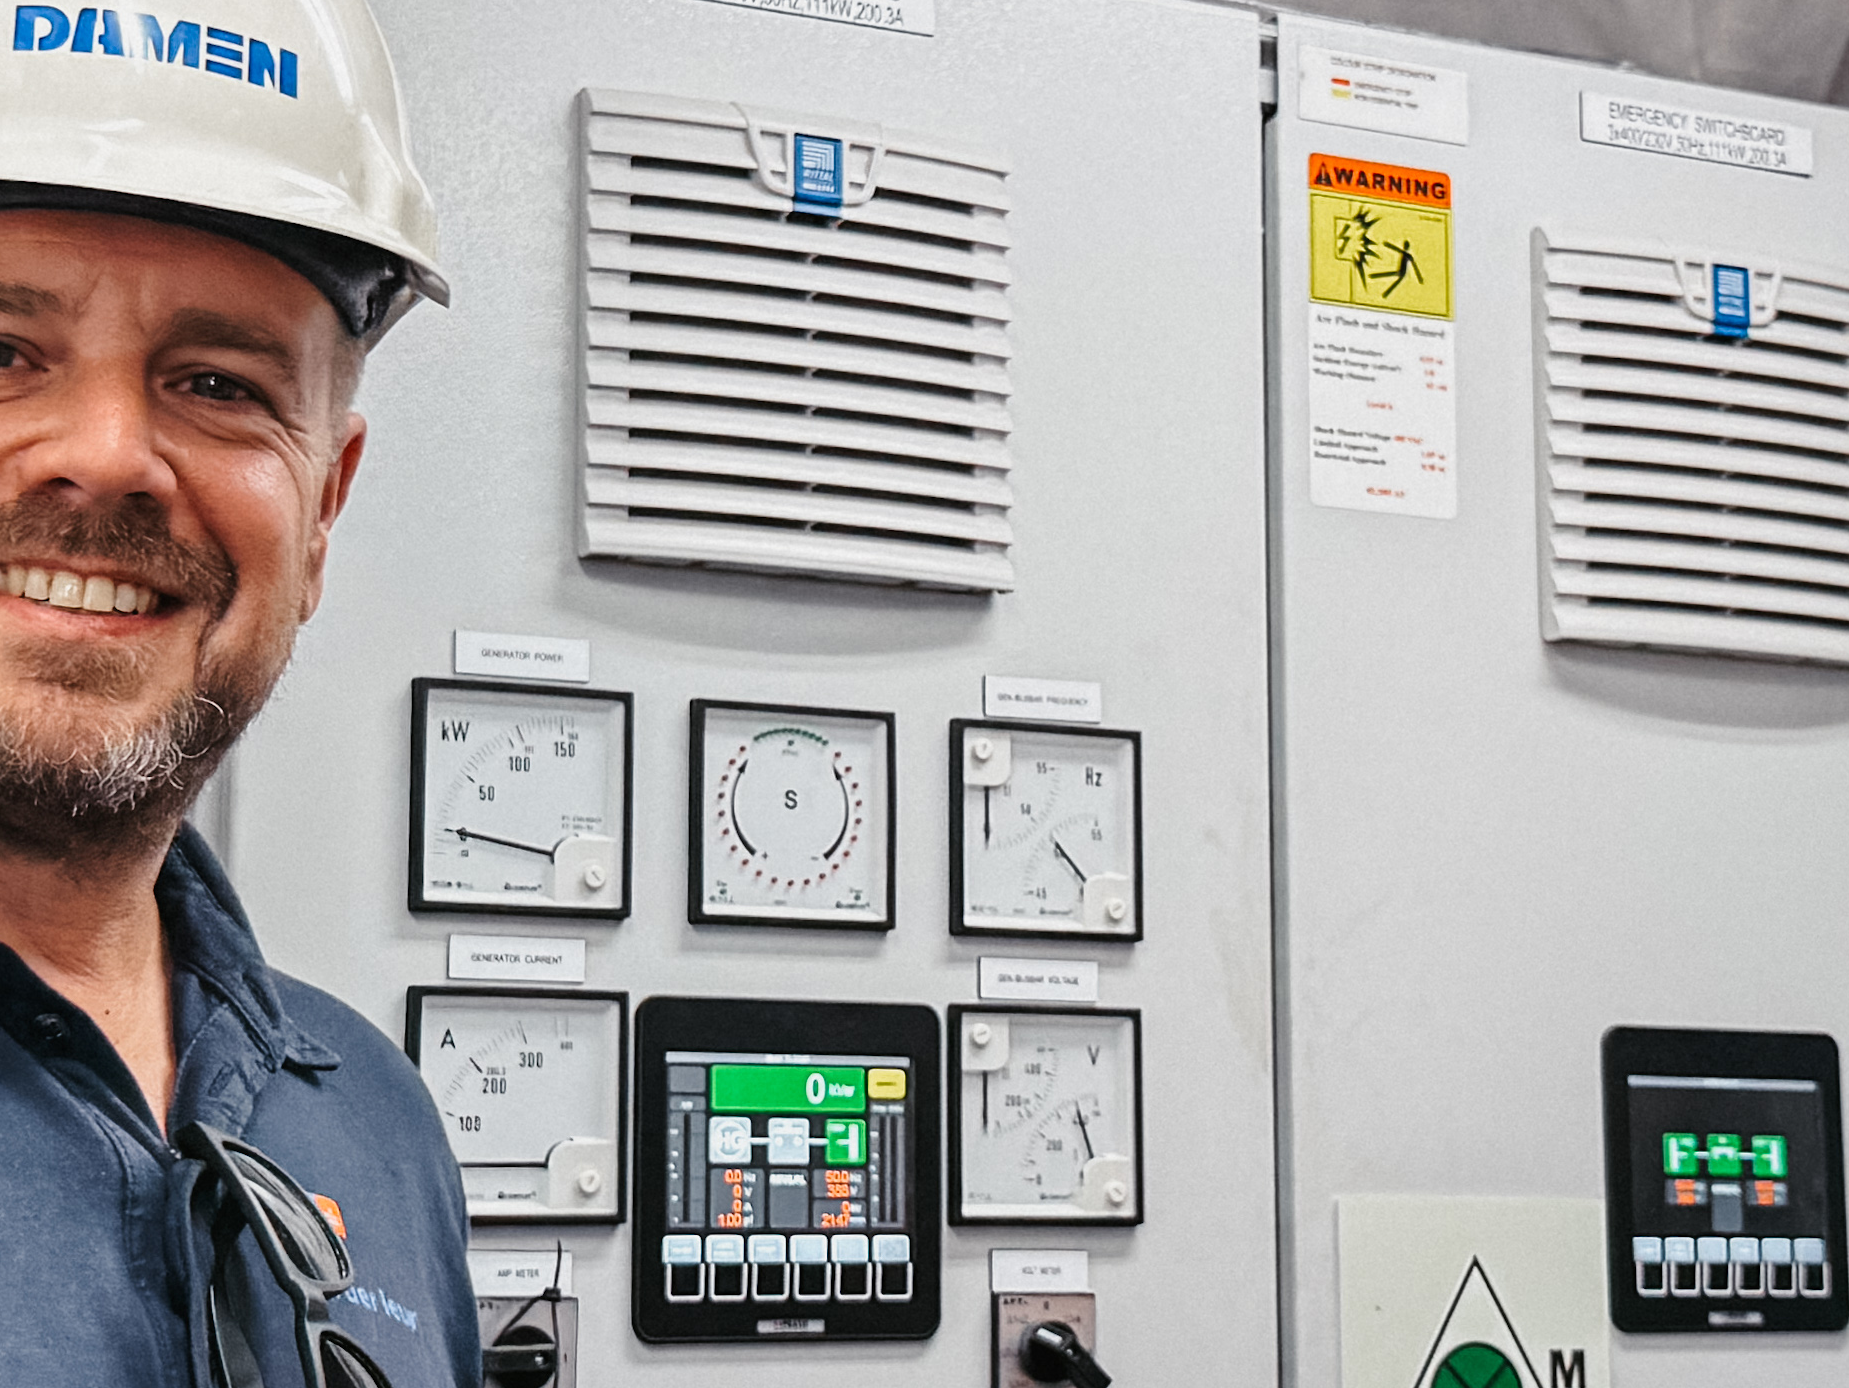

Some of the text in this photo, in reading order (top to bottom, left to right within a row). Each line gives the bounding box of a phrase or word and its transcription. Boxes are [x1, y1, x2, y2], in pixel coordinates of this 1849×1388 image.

[12, 5, 298, 99] DAMEN
[1334, 167, 1446, 200] WARNING
[441, 720, 470, 743] kW
[554, 742, 575, 758] 150
[509, 756, 531, 772] 100
[1085, 766, 1103, 787] Hz
[479, 785, 495, 801] 50
[784, 789, 798, 810] S
[441, 1028, 456, 1049] A
[519, 1052, 543, 1069] 300
[1088, 1044, 1101, 1065] V
[482, 1077, 507, 1094] 200
[806, 1073, 826, 1104] 0
[459, 1115, 481, 1132] 100
